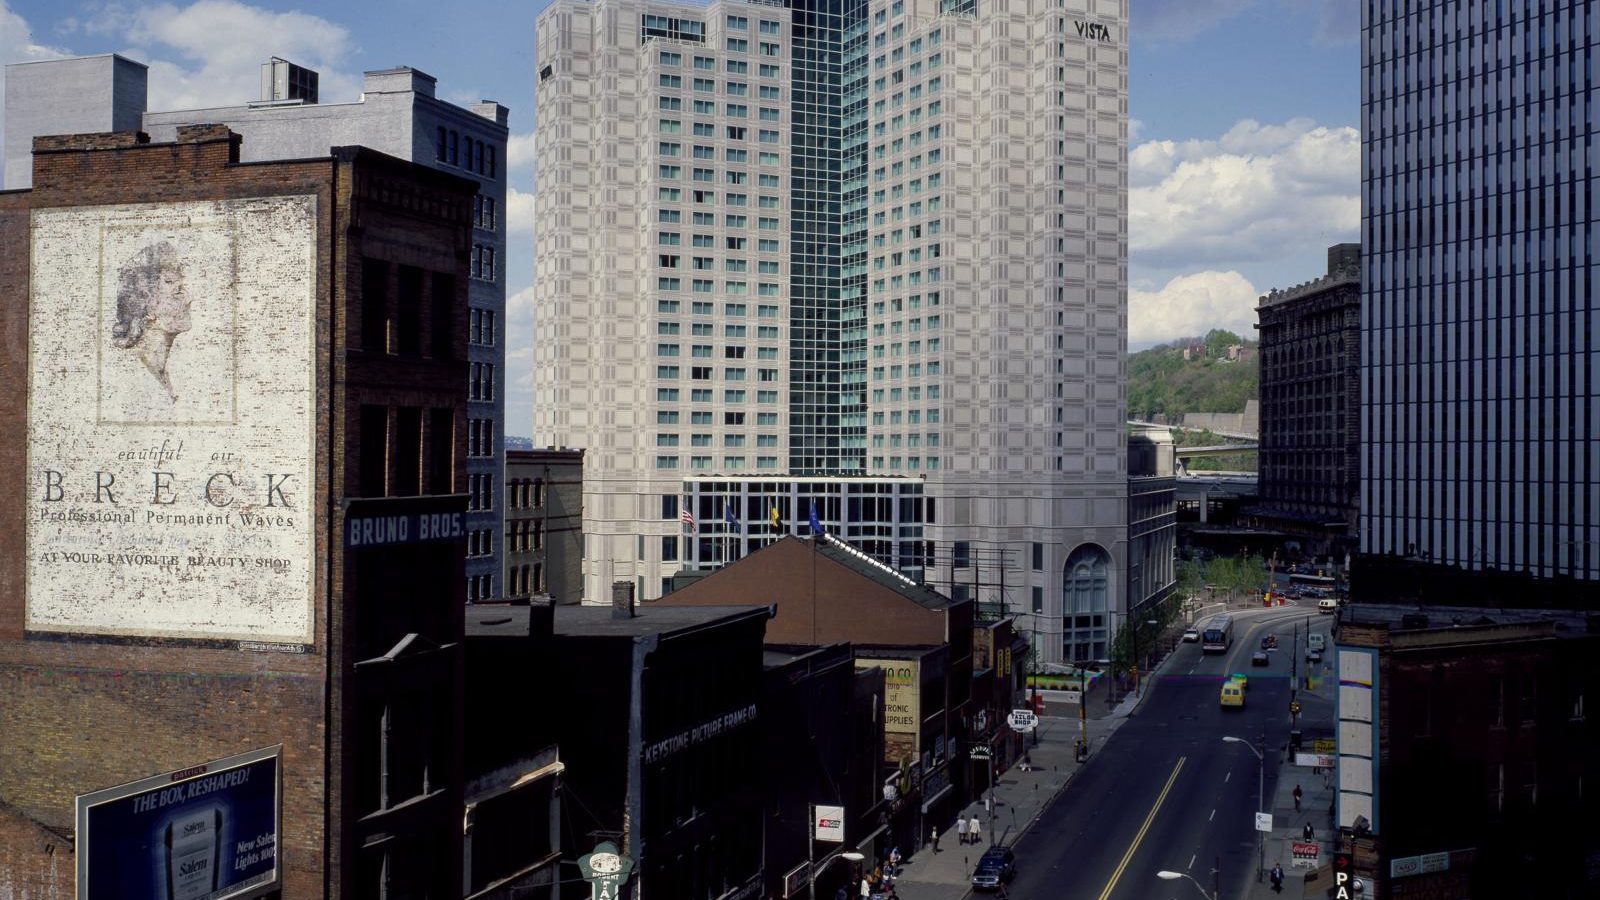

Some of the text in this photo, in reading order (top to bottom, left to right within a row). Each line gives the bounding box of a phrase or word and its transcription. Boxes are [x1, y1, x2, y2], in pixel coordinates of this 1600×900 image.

[1074, 20, 1111, 42] VISTA
[42, 470, 296, 508] BRECK
[40, 508, 295, 528] Professional Permanent Waves
[350, 512, 465, 545] BRUNO BROS.
[40, 552, 291, 569] AT YOUR FAVORITE BEAUTY SHOP
[645, 732, 689, 764] KEYSTONE
[691, 717, 722, 745] PICTURE
[724, 708, 747, 730] FRAME
[132, 767, 251, 815] THE BOX, RESHAPED!
[184, 821, 205, 833] Salem
[237, 840, 256, 855] New
[179, 858, 208, 877] Salem
[234, 851, 260, 871] Lights
